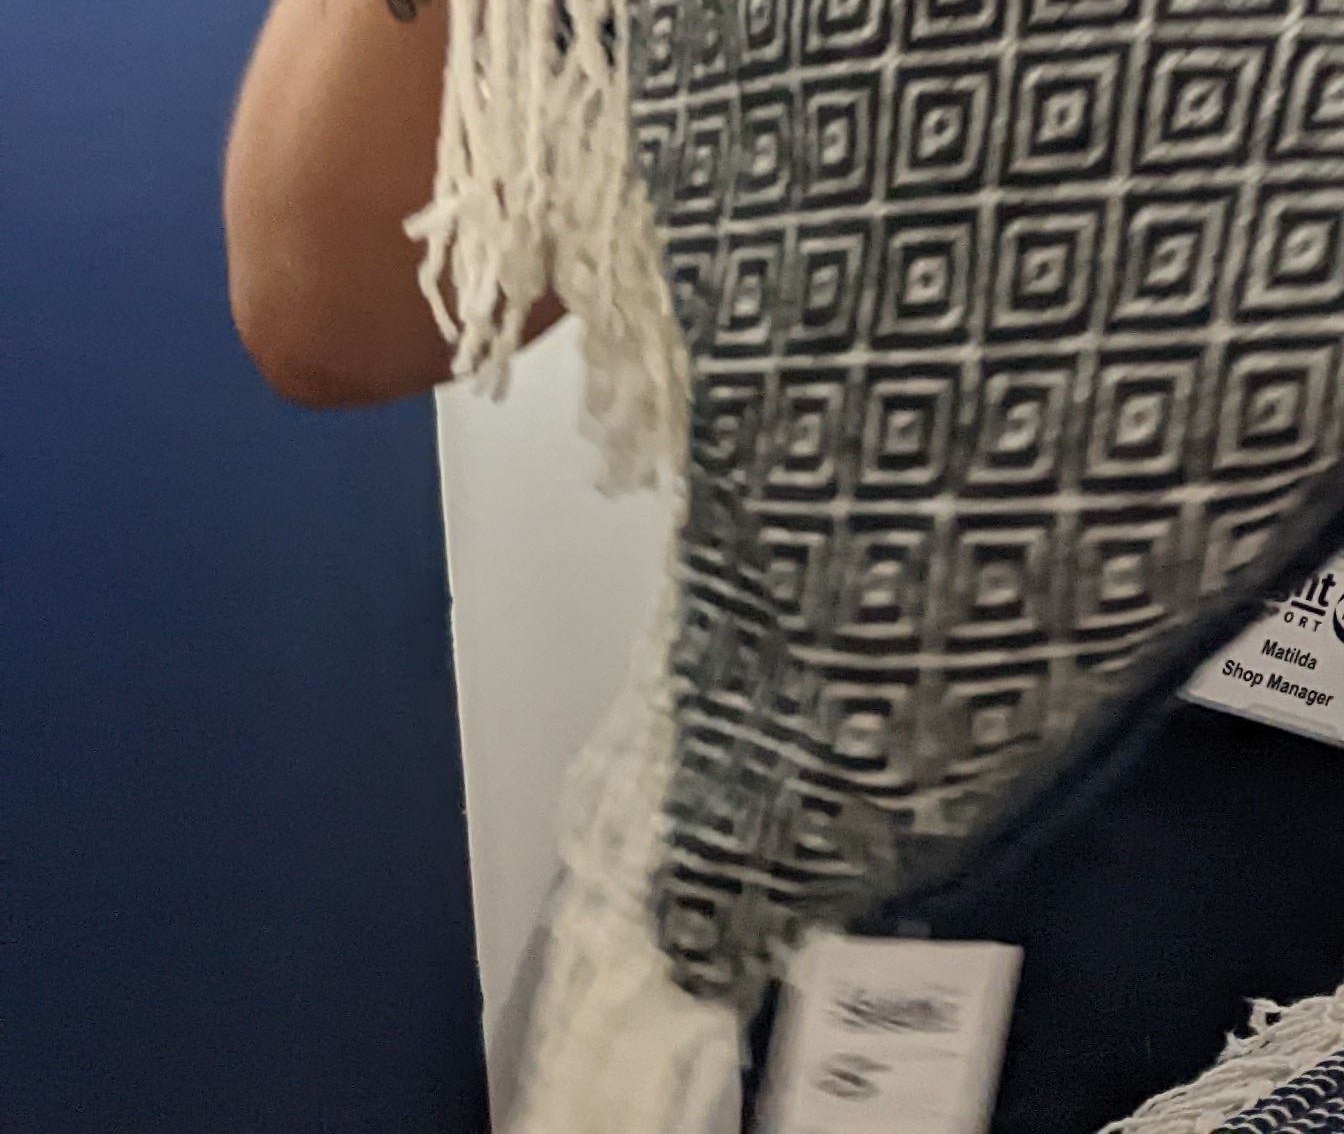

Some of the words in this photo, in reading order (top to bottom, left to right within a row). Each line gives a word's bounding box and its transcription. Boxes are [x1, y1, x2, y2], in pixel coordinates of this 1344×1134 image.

[1261, 639, 1318, 670] Matilda
[1222, 659, 1264, 688] Shop
[1266, 672, 1335, 707] Manager
